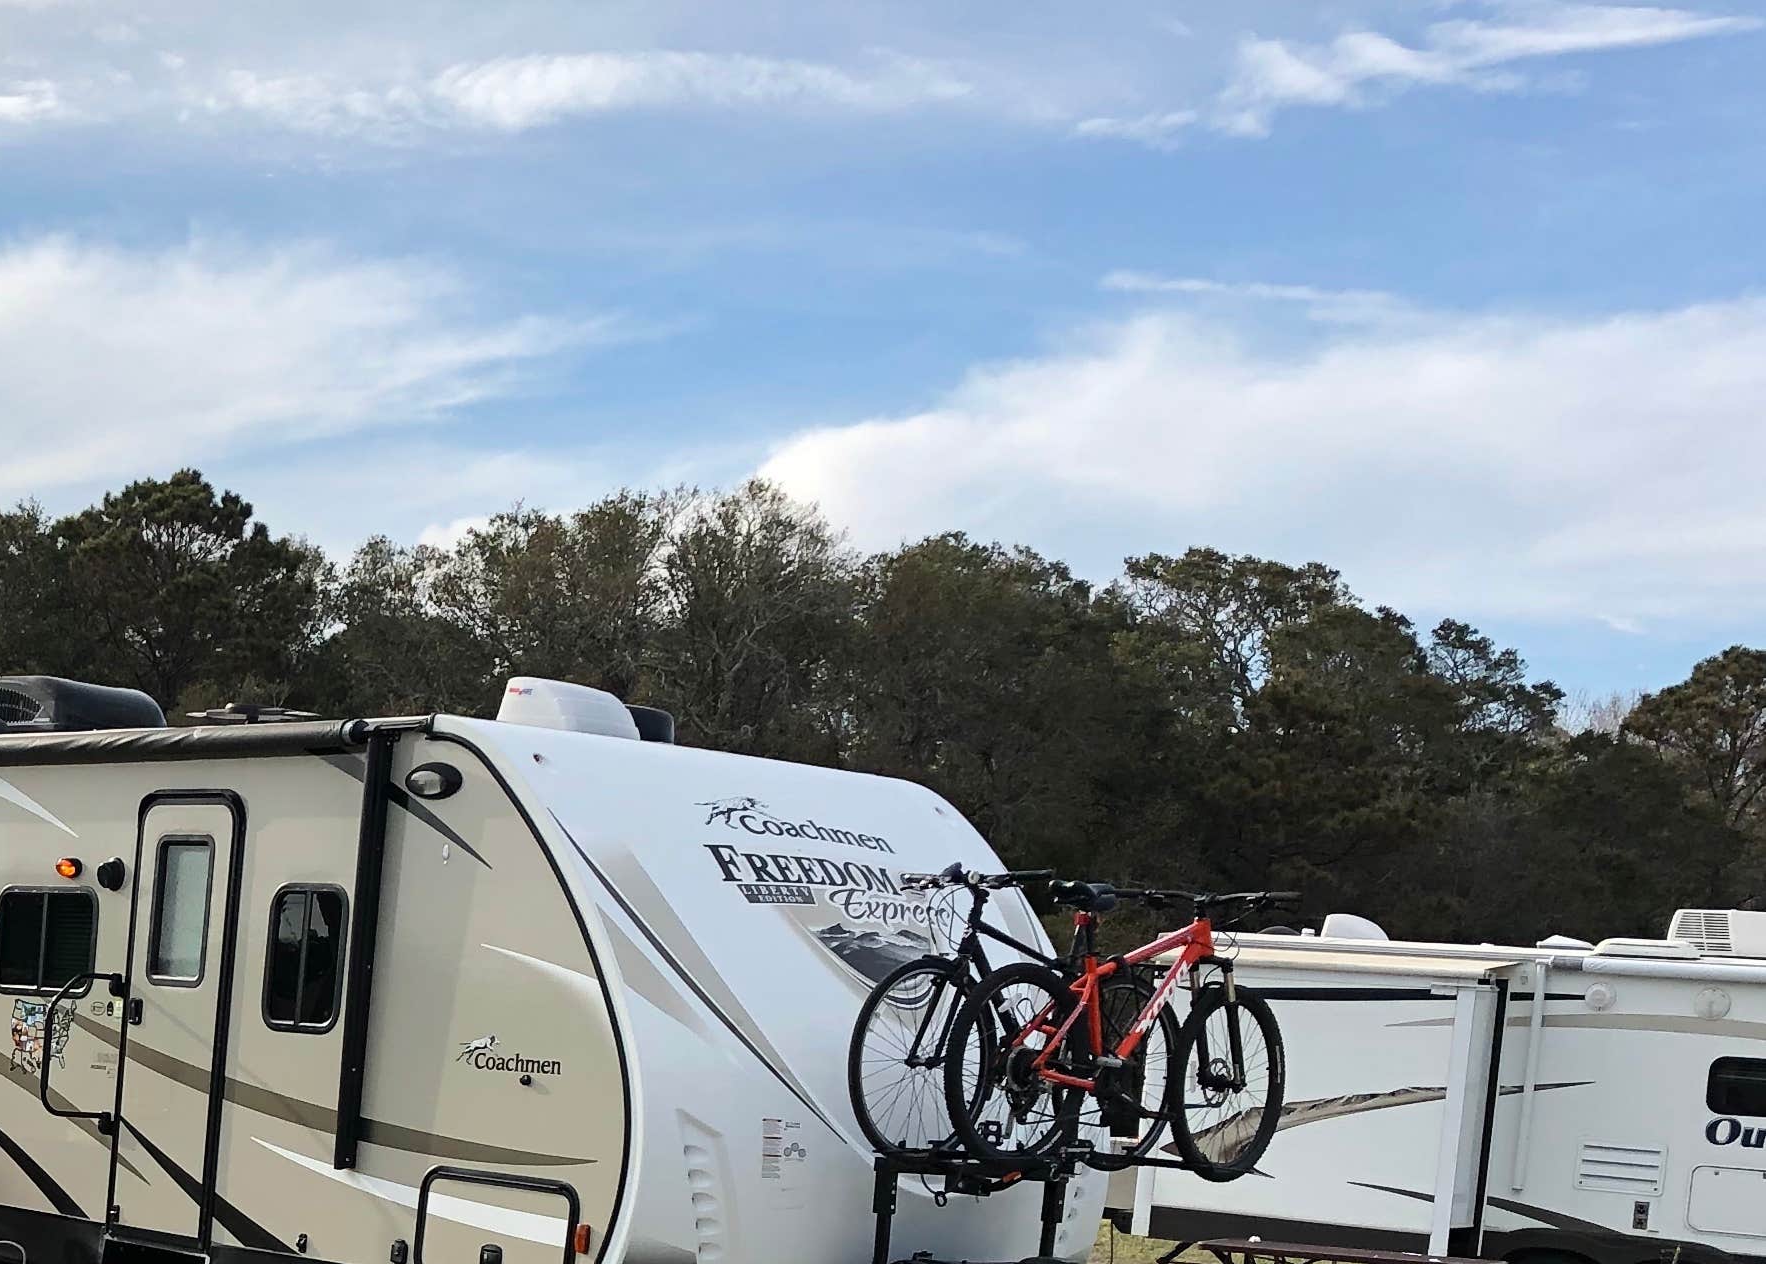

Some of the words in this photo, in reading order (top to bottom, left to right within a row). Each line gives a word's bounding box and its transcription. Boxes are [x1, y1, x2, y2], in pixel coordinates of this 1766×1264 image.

[740, 814, 895, 854] Coachmen
[704, 844, 902, 895] FREEDOM
[741, 885, 810, 896] LIBERTY
[758, 894, 803, 903] EDITION
[474, 1053, 561, 1075] Coachmen
